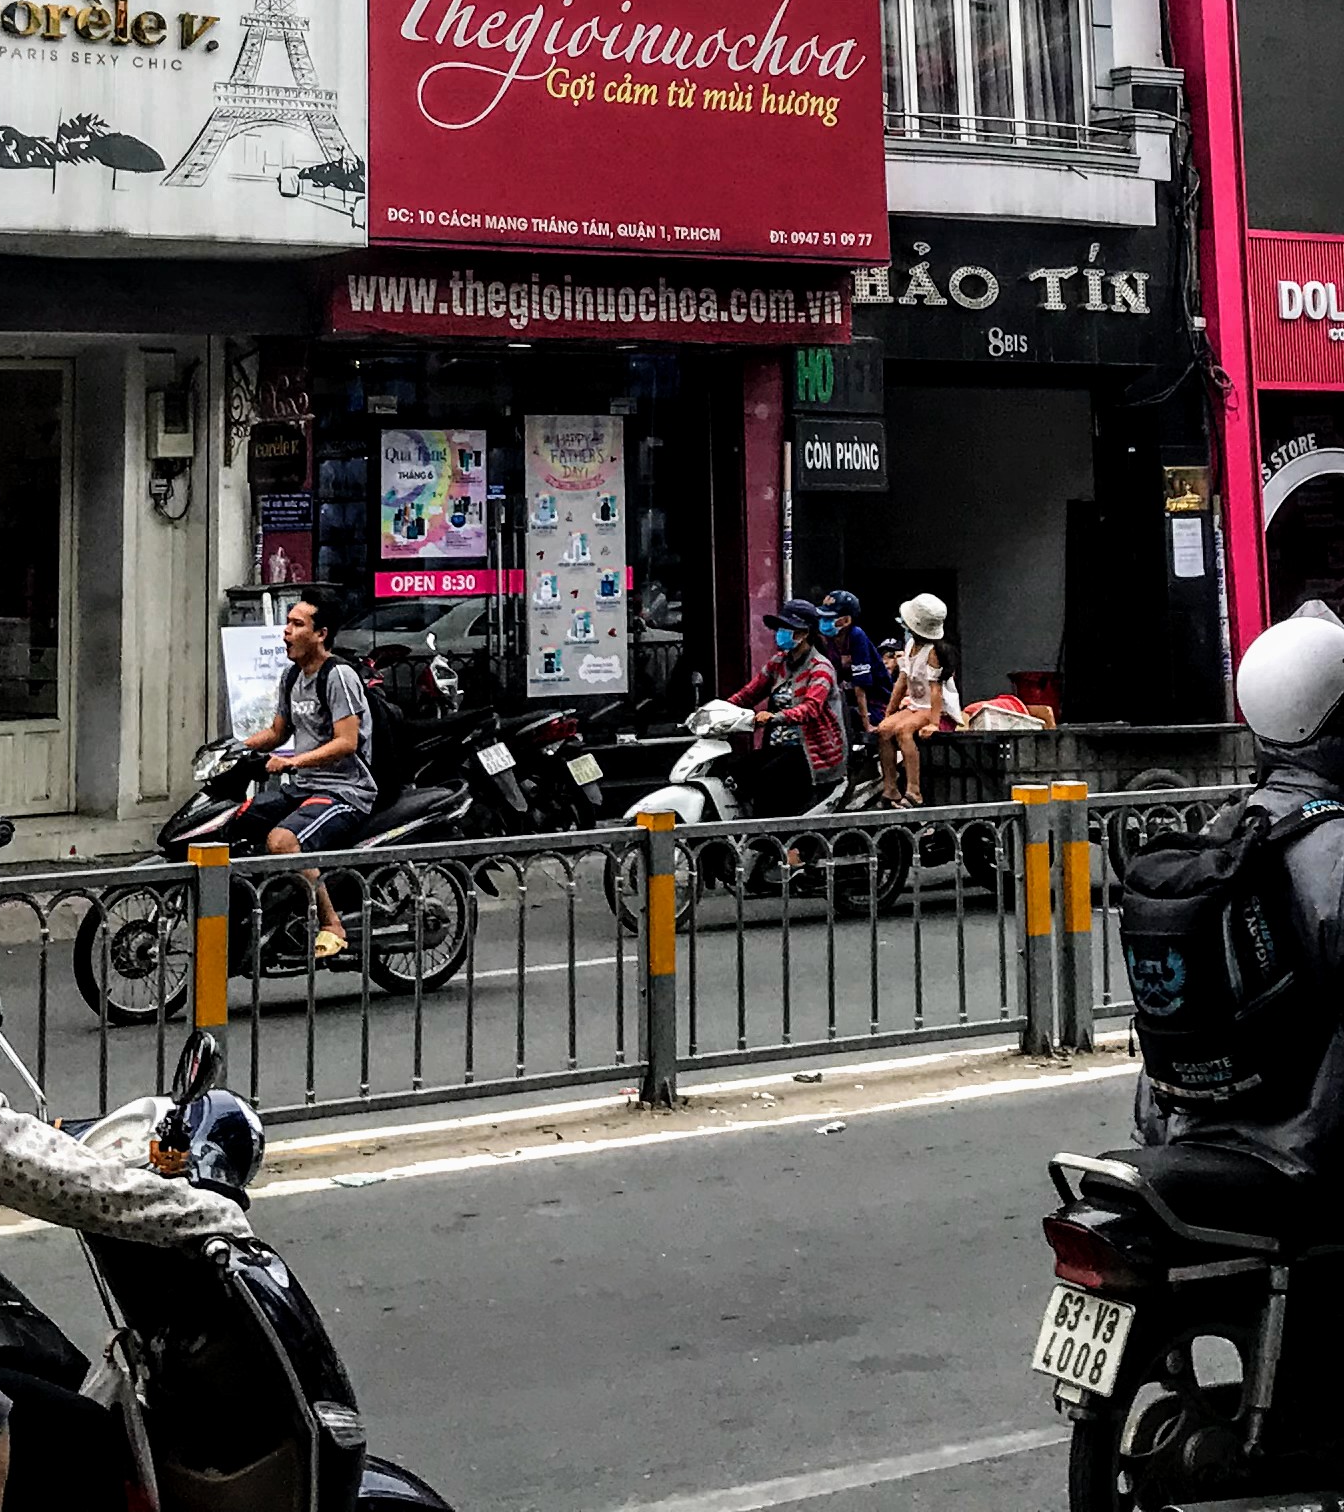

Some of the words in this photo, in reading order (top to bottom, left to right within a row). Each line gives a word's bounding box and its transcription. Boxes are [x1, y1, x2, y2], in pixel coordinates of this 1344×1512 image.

[177, 12, 221, 53] v.
[71, 52, 120, 68] SEXY
[132, 56, 184, 72] CHIC
[545, 66, 596, 105] Gợi
[603, 71, 658, 106] cảm
[666, 78, 696, 109] từ
[702, 82, 754, 113] mùi
[760, 84, 840, 127] hương
[387, 208, 415, 224] ĐC:
[418, 209, 435, 225] 10
[438, 208, 482, 228] CÁCH
[485, 214, 529, 234] MẠNG
[531, 215, 579, 234] THÁNG
[582, 218, 614, 239] TÁM,
[617, 221, 656, 242] QUẬN
[660, 225, 672, 242] 1,
[674, 226, 721, 242] TP.HCM
[769, 230, 789, 244] ĐT:
[791, 231, 820, 245] 0947
[823, 232, 837, 246] 51
[840, 233, 856, 246] 09
[858, 233, 873, 247] 77
[1028, 242, 1151, 315] TÍN
[348, 270, 843, 329] www.thegioinuochoa.com.vn
[804, 433, 832, 470] CÒN
[836, 434, 880, 471] PHÒNG
[1270, 432, 1318, 469] STORE
[391, 576, 436, 592] OPEN
[442, 574, 476, 590] 8:30
